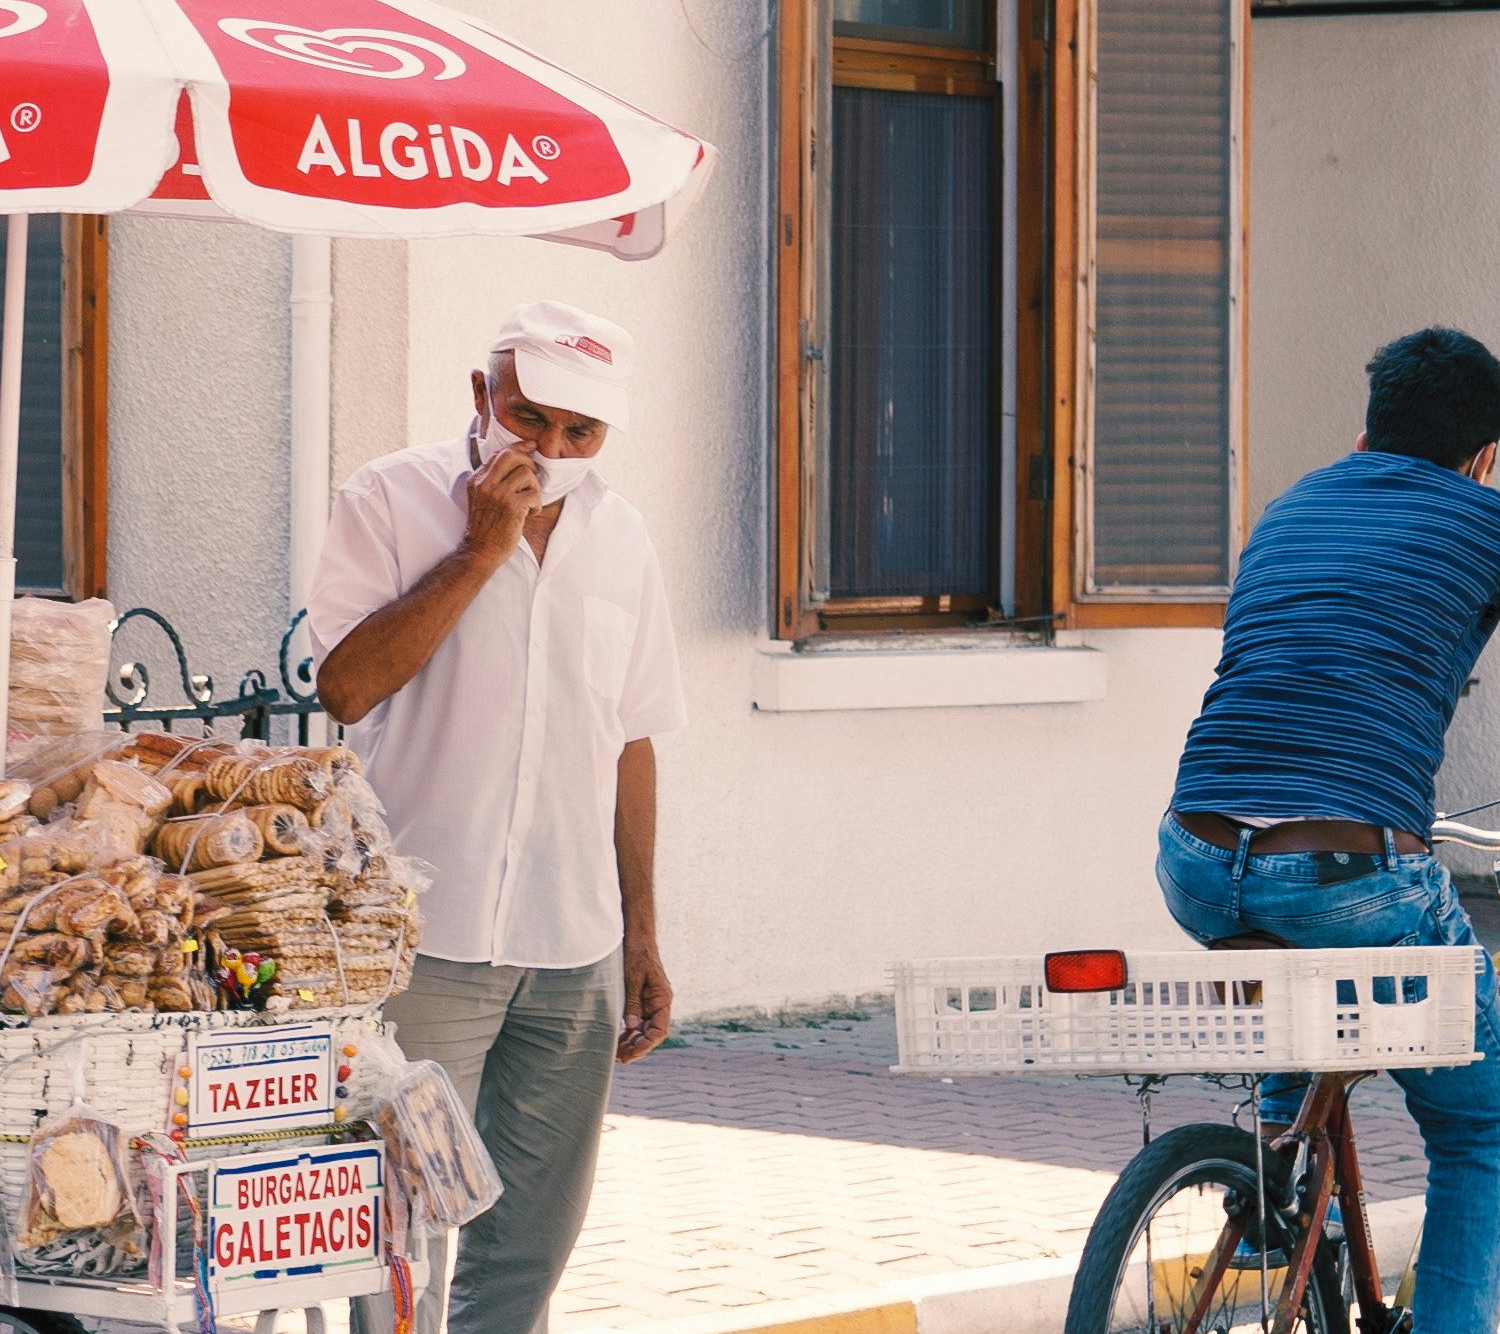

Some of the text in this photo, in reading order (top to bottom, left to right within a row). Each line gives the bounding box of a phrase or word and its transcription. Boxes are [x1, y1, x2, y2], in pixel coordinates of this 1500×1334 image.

[209, 1073, 318, 1113] TAZELER
[238, 1165, 363, 1210] BURGAZADA
[216, 1204, 371, 1267] GALETACIS
